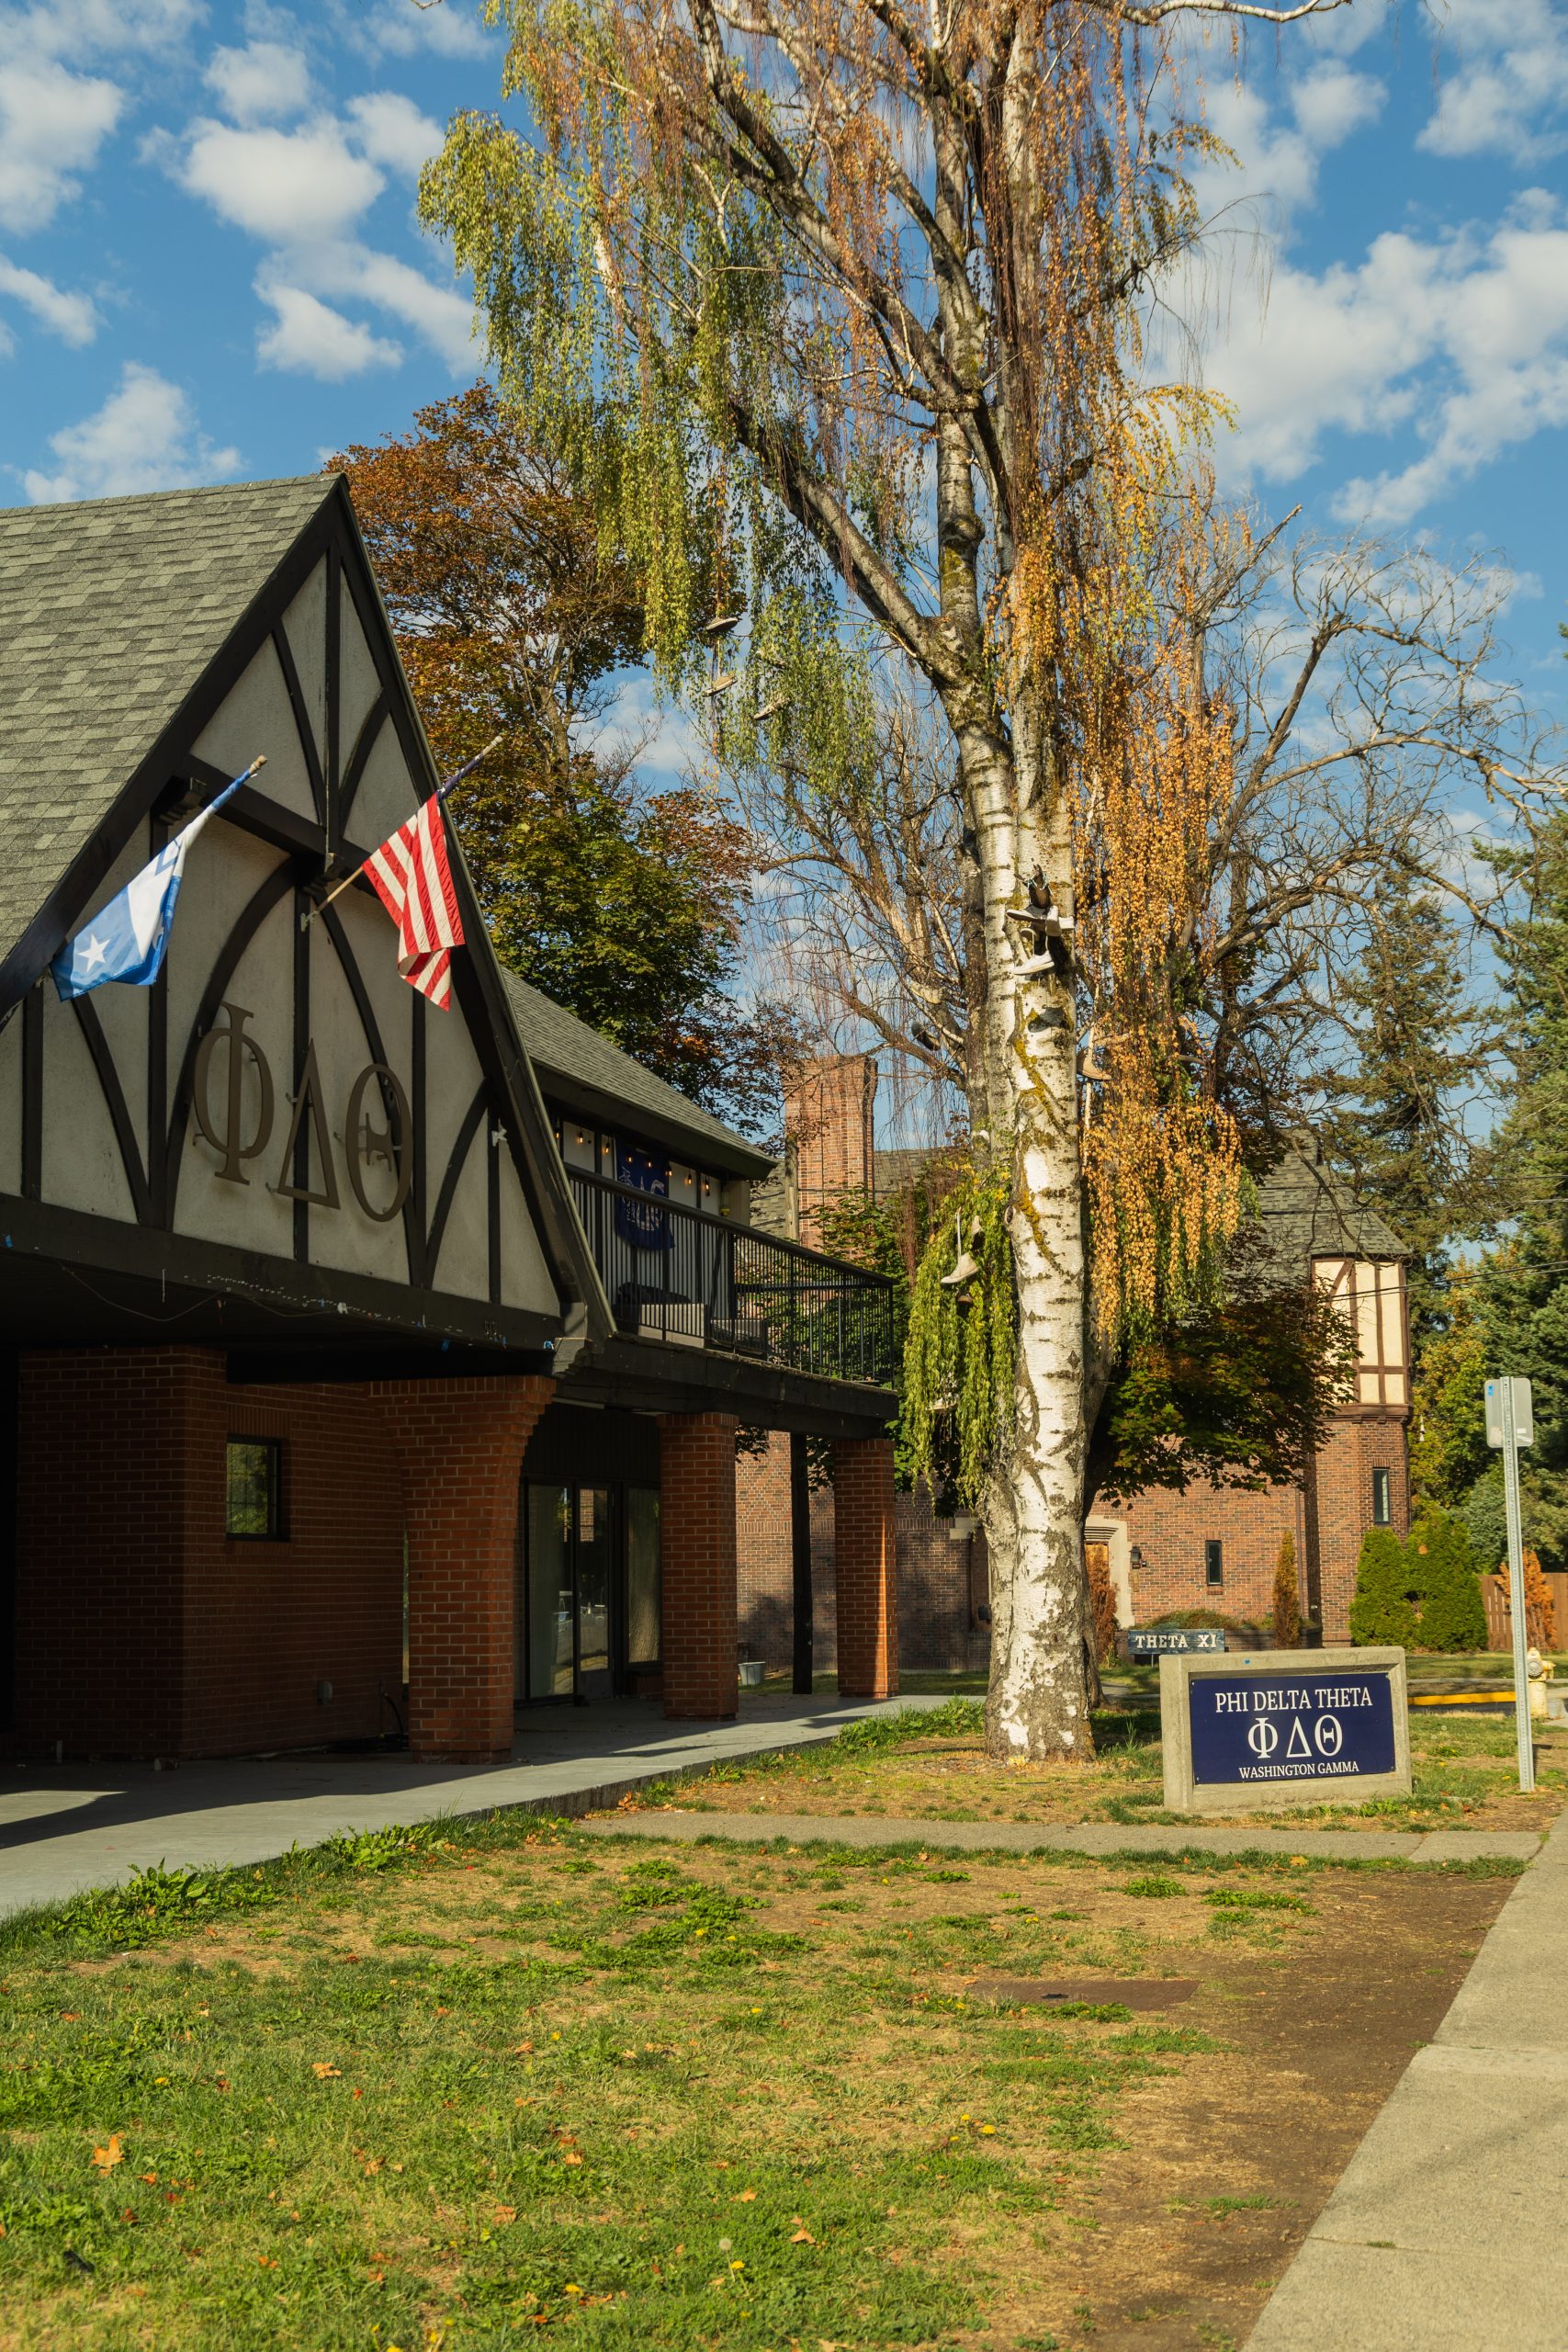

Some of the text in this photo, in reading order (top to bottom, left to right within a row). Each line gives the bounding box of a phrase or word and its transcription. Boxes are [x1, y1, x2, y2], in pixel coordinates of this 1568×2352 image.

[1135, 1634, 1217, 1649] THETA XI
[1214, 1687, 1373, 1713] PHI DELTA THETA
[1238, 1760, 1359, 1780] WASHINGTON GAMMA
